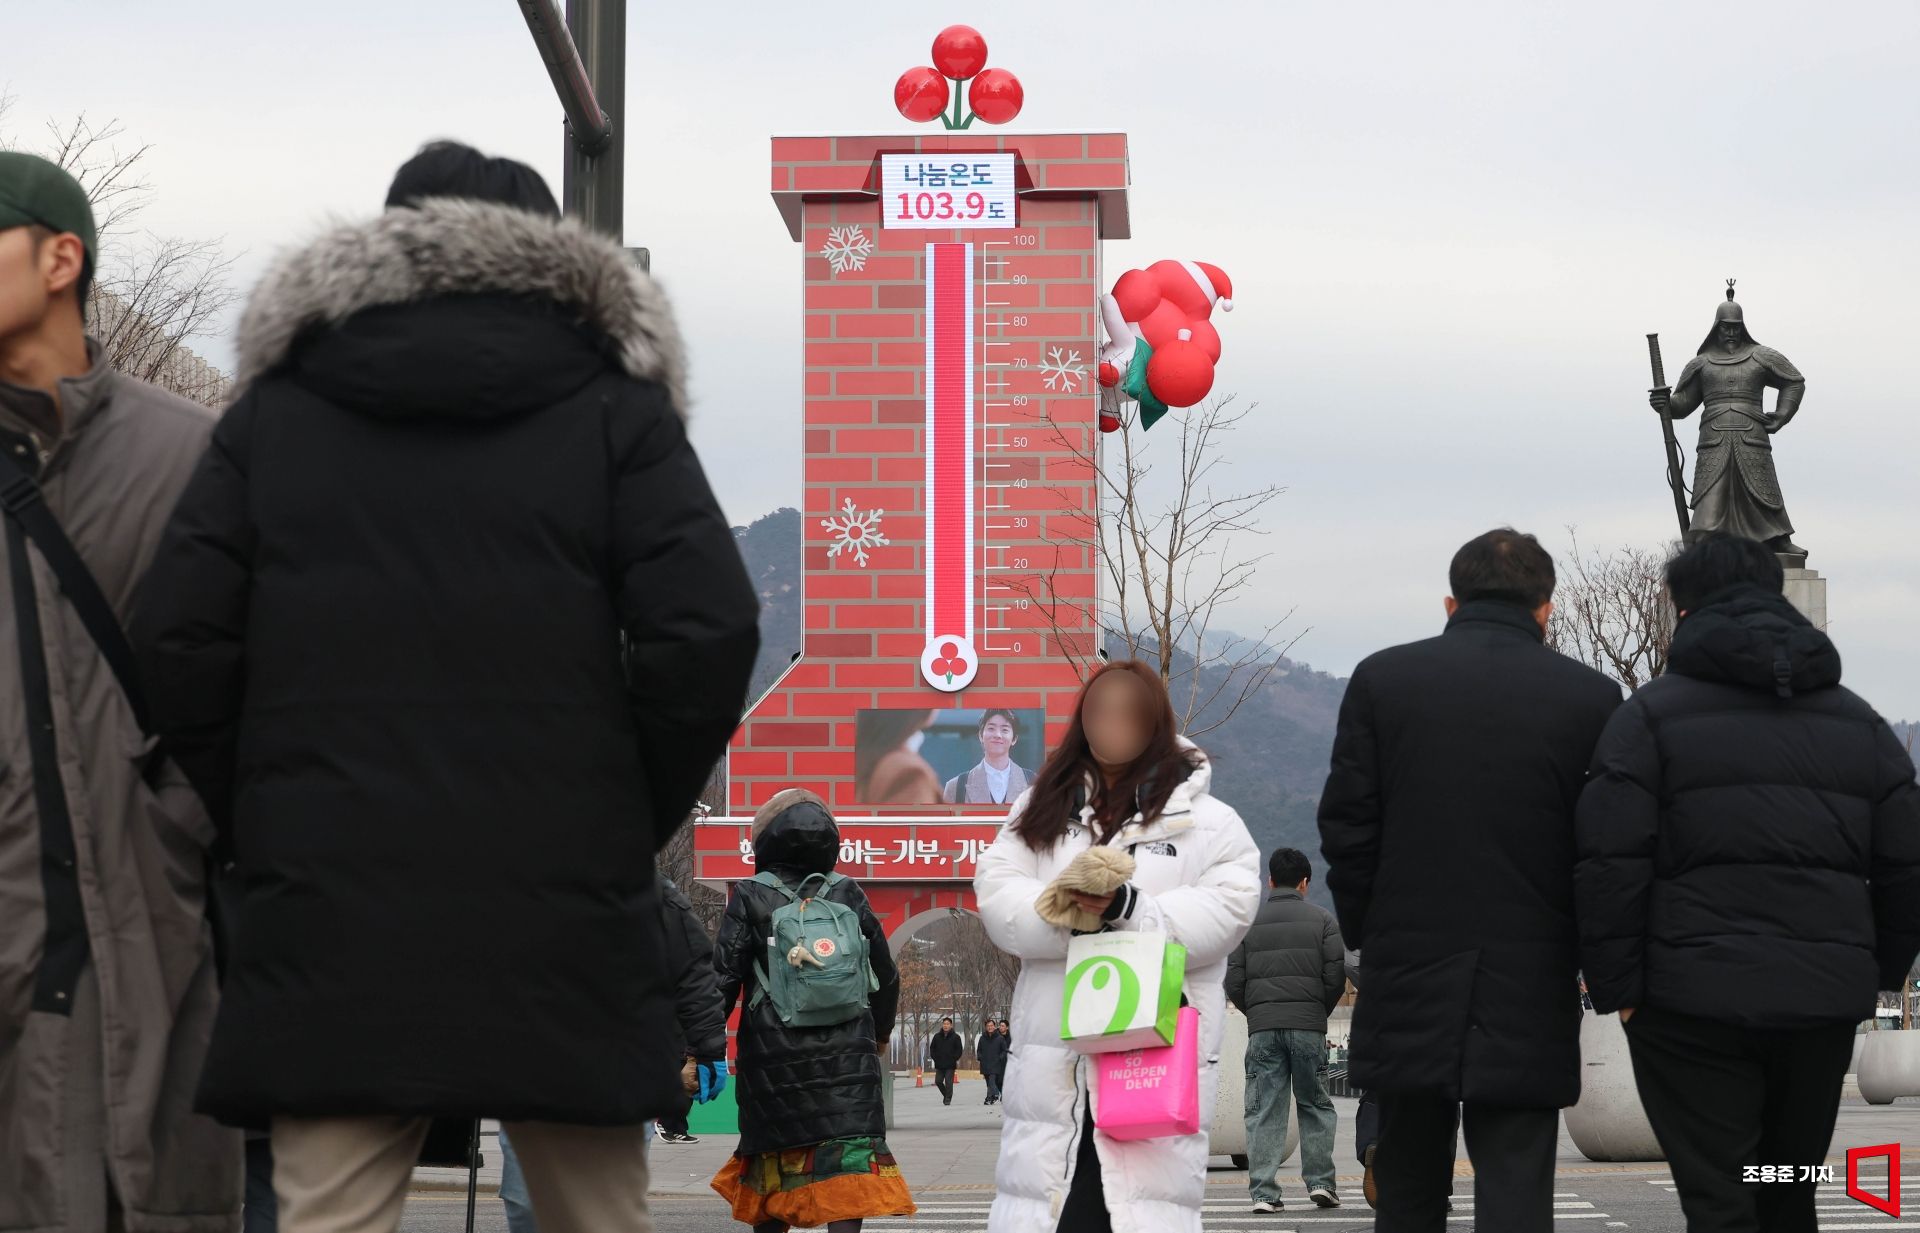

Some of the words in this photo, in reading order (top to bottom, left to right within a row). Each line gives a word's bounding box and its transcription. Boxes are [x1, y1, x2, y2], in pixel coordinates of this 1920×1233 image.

[905, 163, 993, 187] 나눔온도
[1014, 235, 1035, 245] 100
[1013, 275, 1028, 285] 90
[1013, 316, 1028, 326] 80
[1013, 359, 1028, 368] 70
[1013, 396, 1028, 406] 60
[1013, 437, 1028, 447] 50
[1013, 479, 1028, 488] 40
[1013, 518, 1028, 528] 30
[1013, 559, 1028, 569] 20
[1014, 600, 1028, 609] 10
[1013, 643, 1021, 652] 0
[836, 839, 886, 865] 하는
[892, 839, 946, 865] 기부,
[1125, 1056, 1142, 1068] SO
[1109, 1065, 1167, 1080] INDEPEN
[1125, 1077, 1161, 1090] DENT
